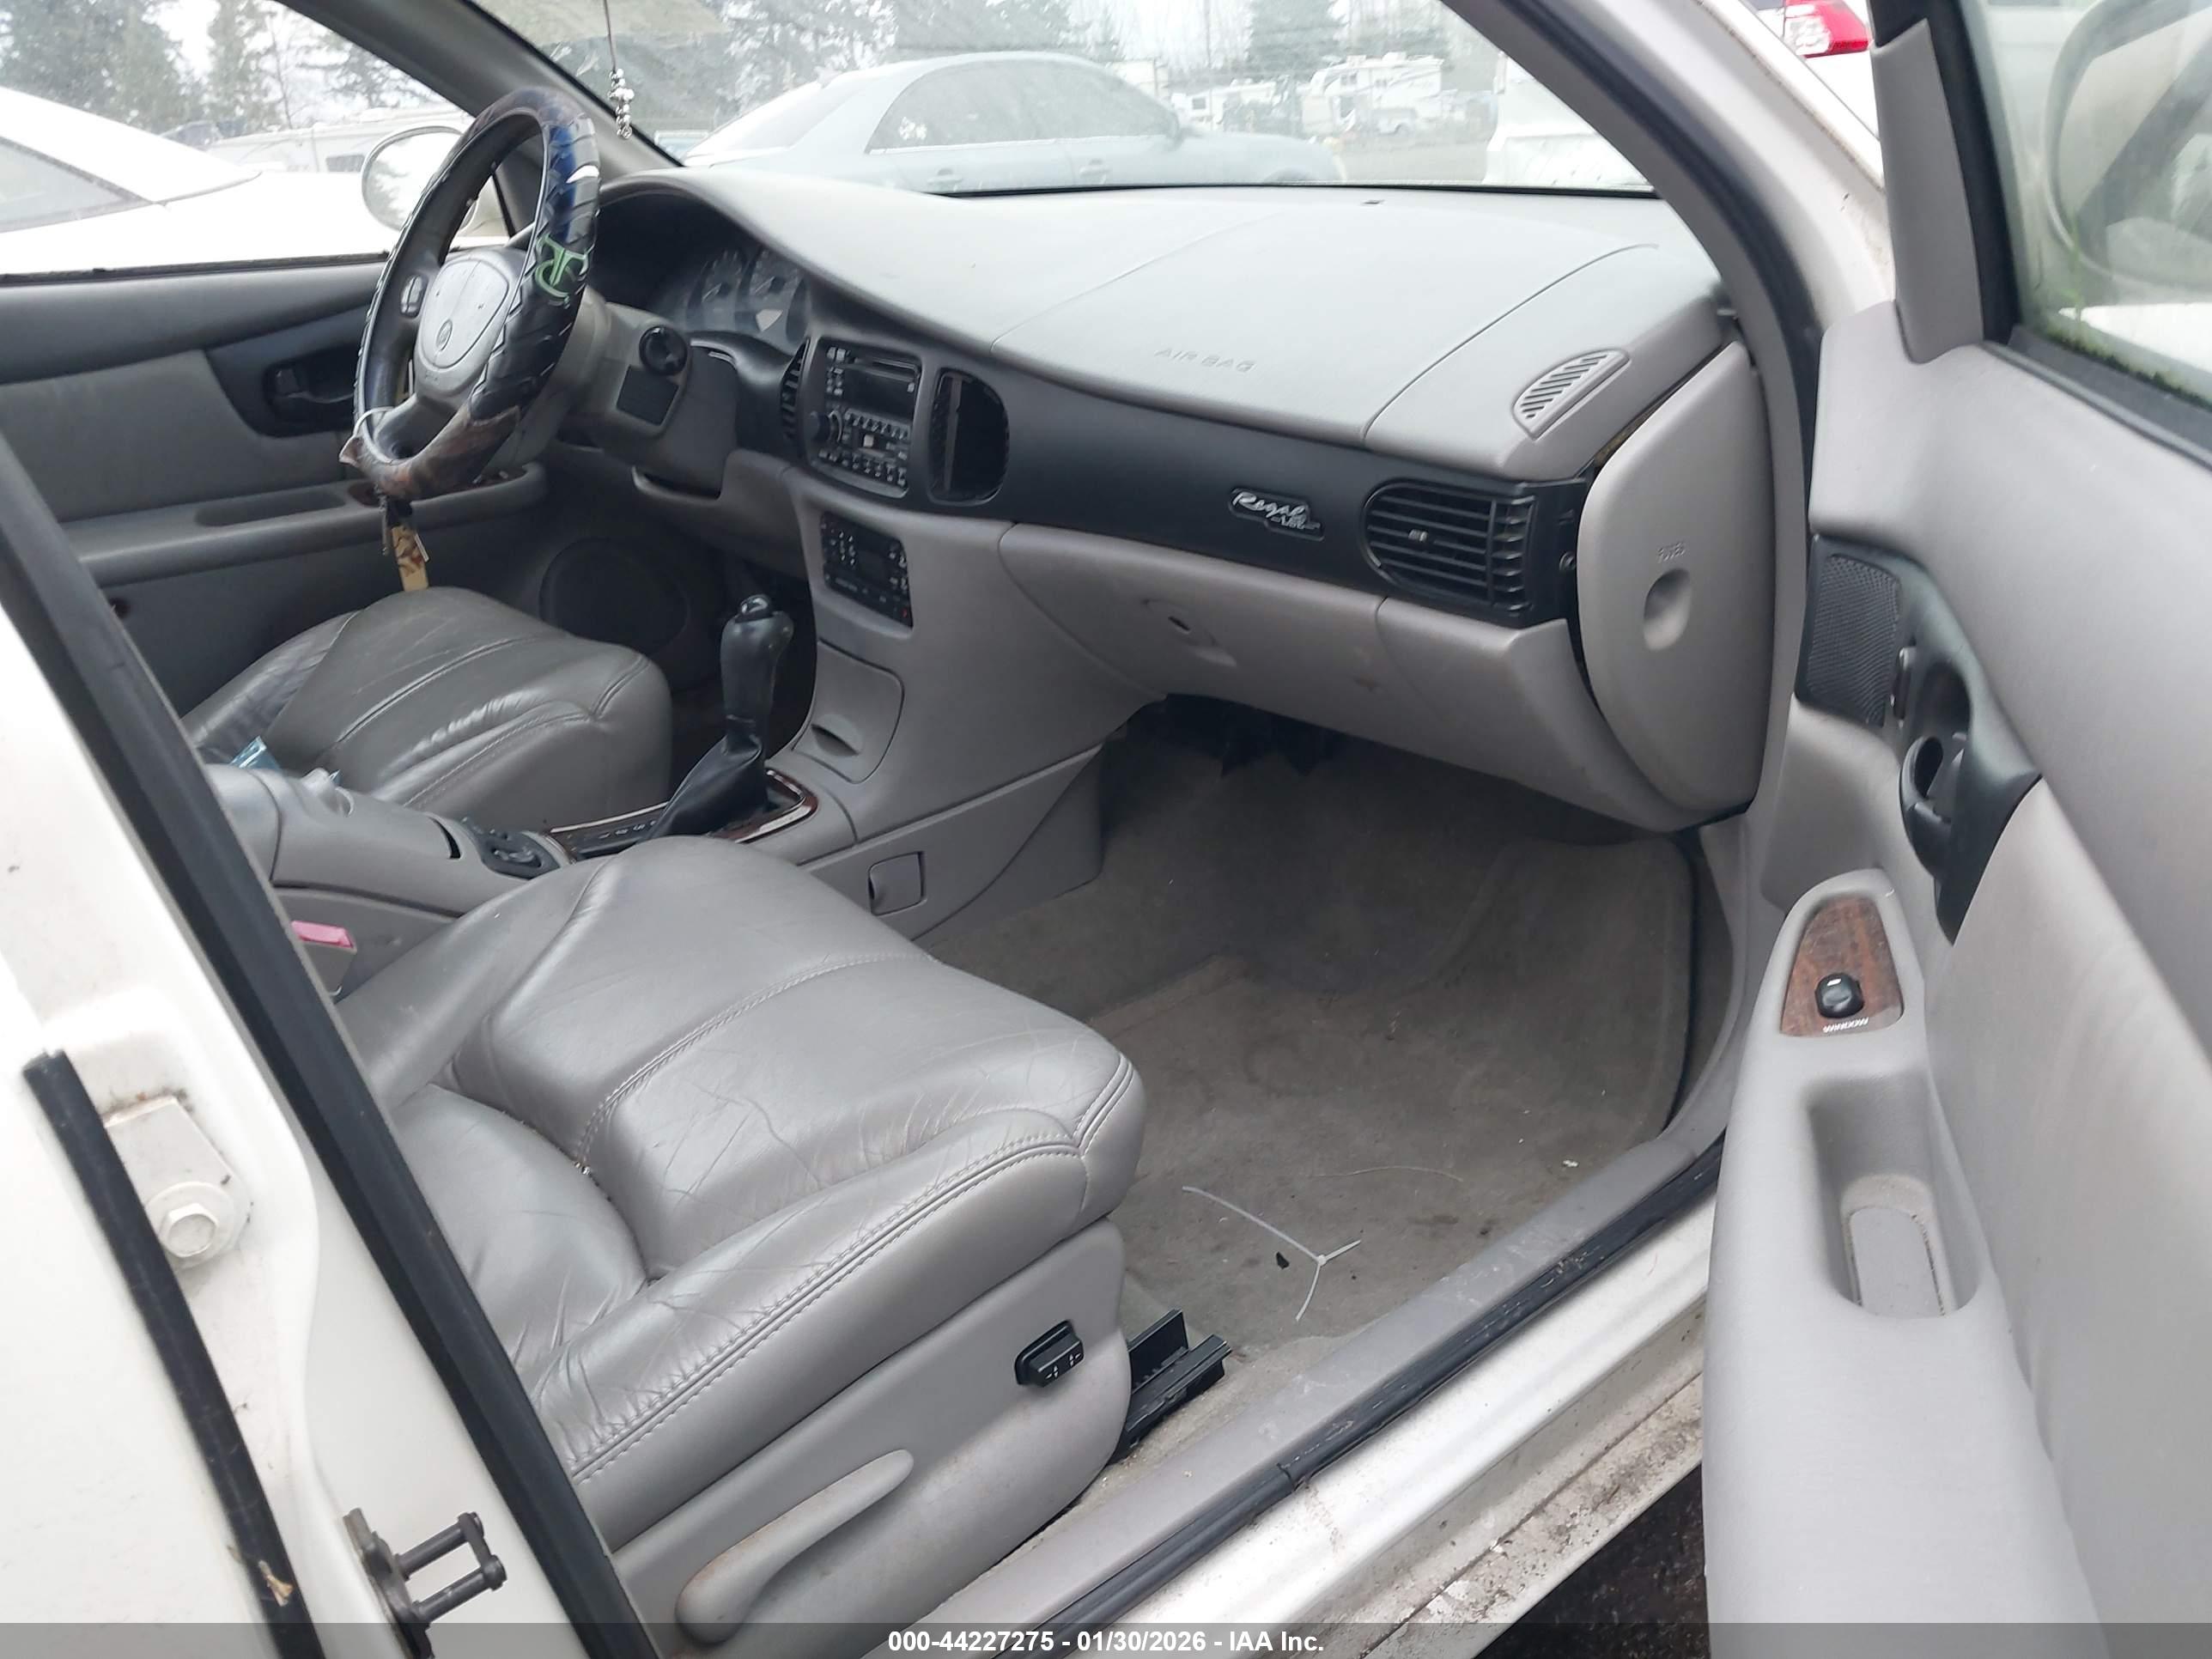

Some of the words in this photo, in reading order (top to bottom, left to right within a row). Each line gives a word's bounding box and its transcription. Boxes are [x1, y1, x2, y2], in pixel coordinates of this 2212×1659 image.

[1152, 348, 1199, 362] AIR
[1200, 354, 1257, 373] BAG
[1232, 491, 1306, 518] Regal
